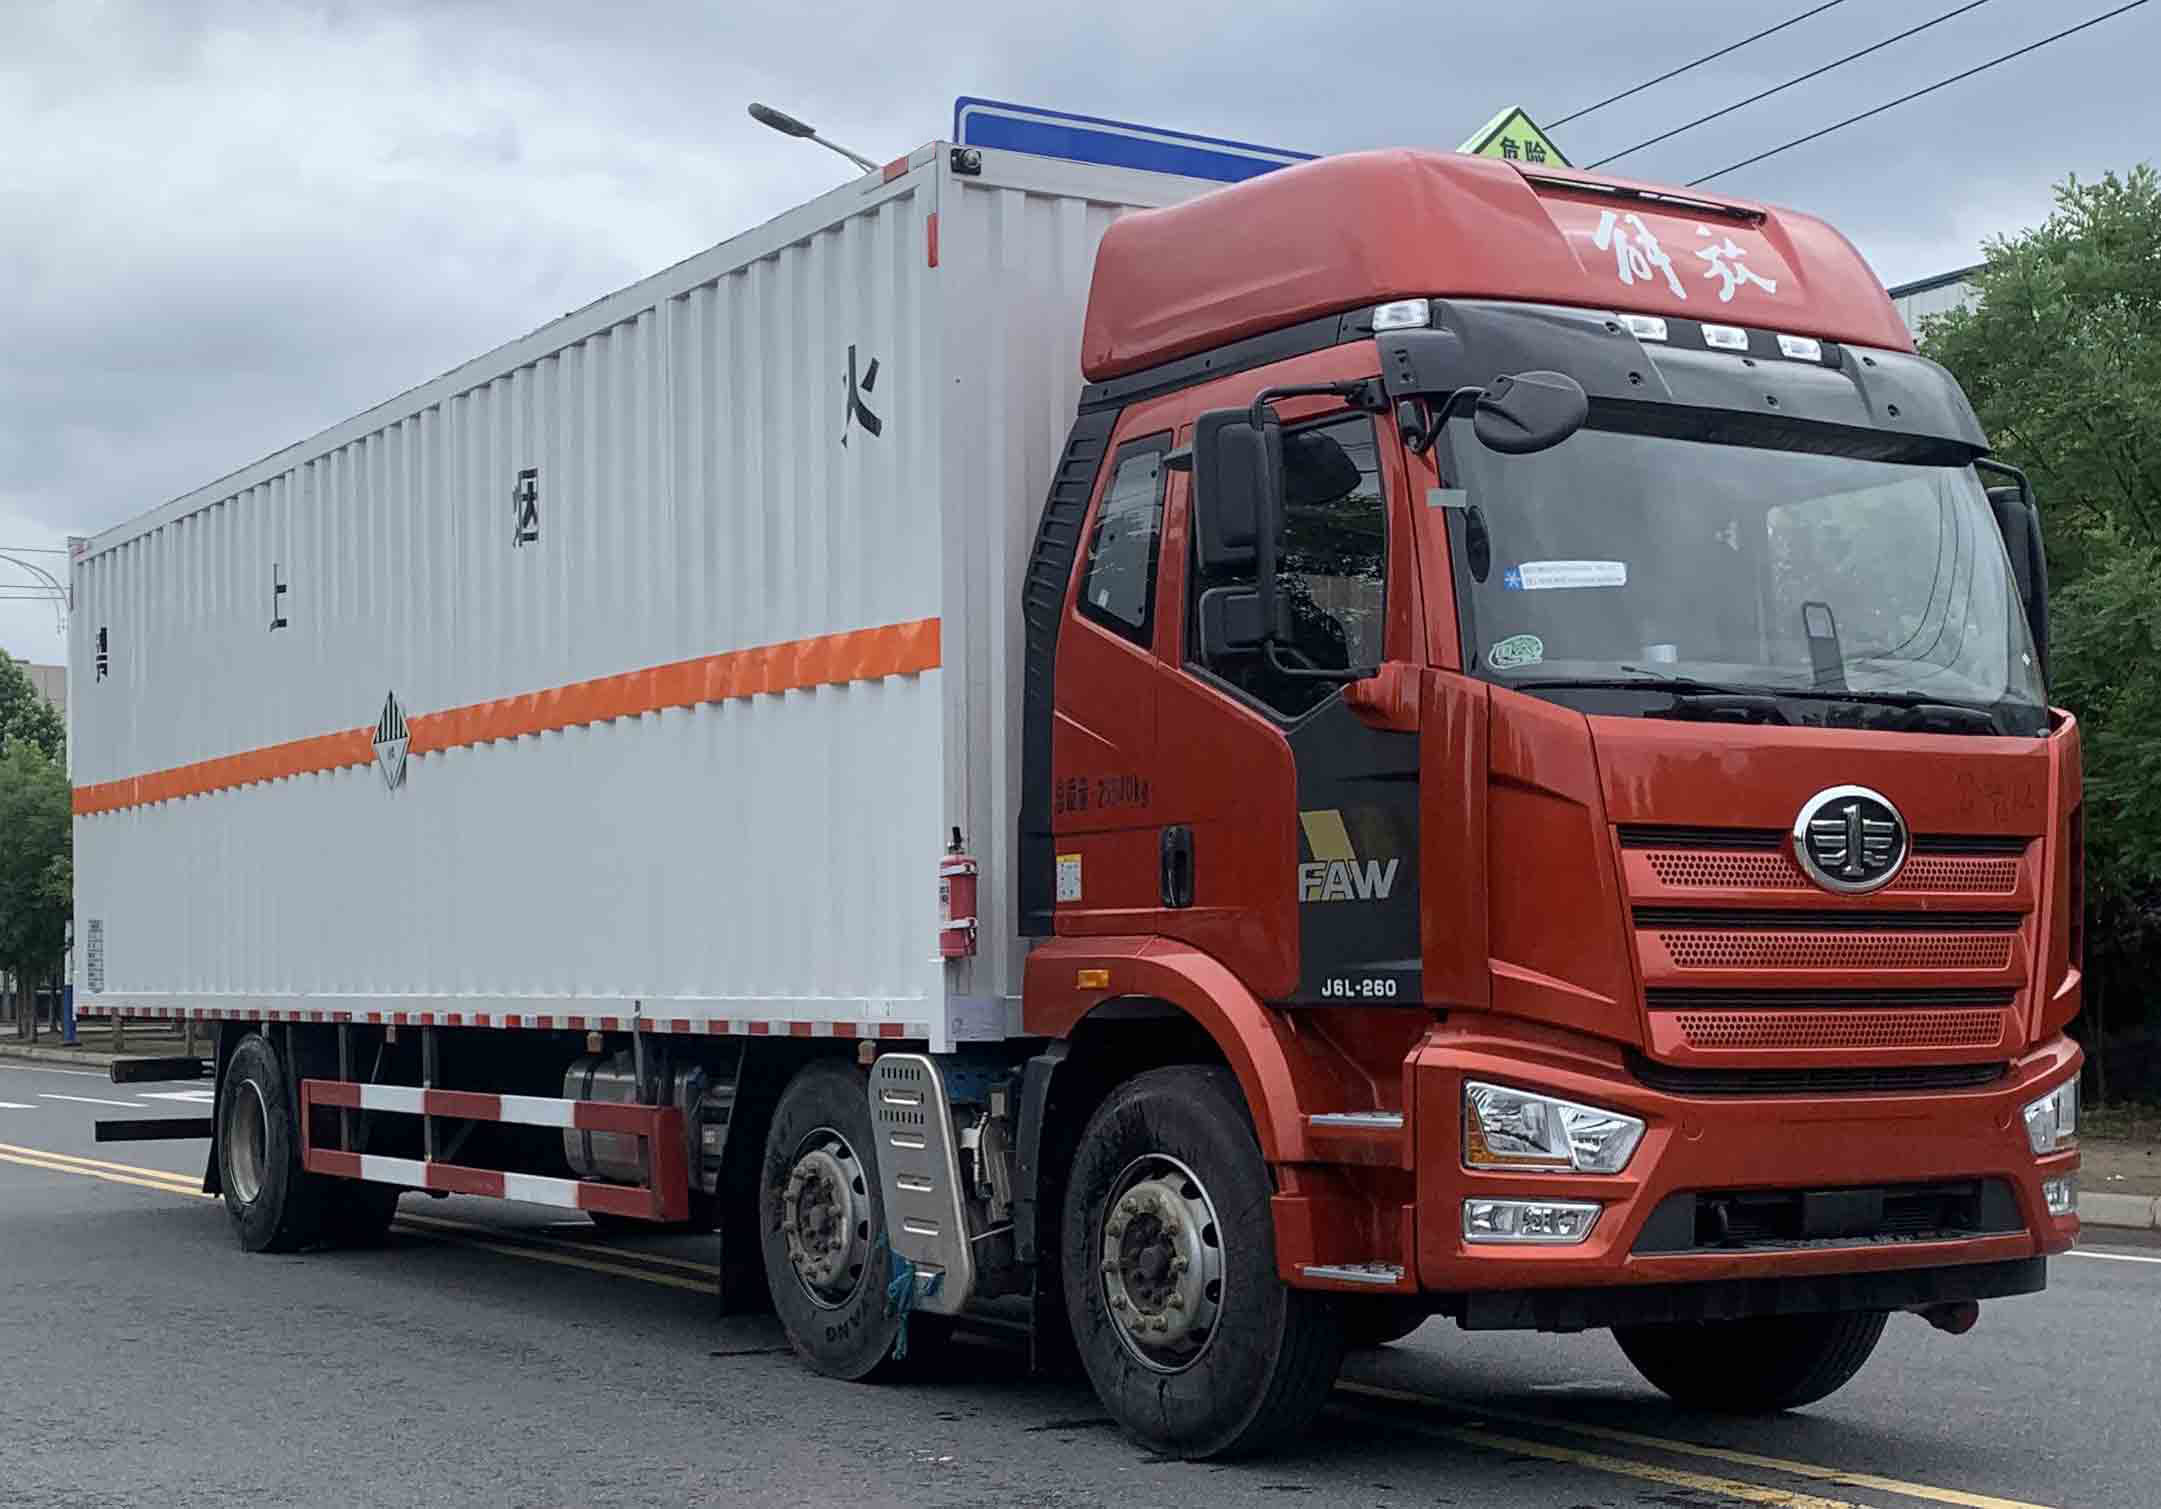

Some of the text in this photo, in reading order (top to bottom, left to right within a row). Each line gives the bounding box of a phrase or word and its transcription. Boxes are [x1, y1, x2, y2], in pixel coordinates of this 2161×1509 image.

[1499, 136, 1547, 162] 危险
[1298, 858, 1400, 903] FAW
[1321, 978, 1397, 998] J6L-260
